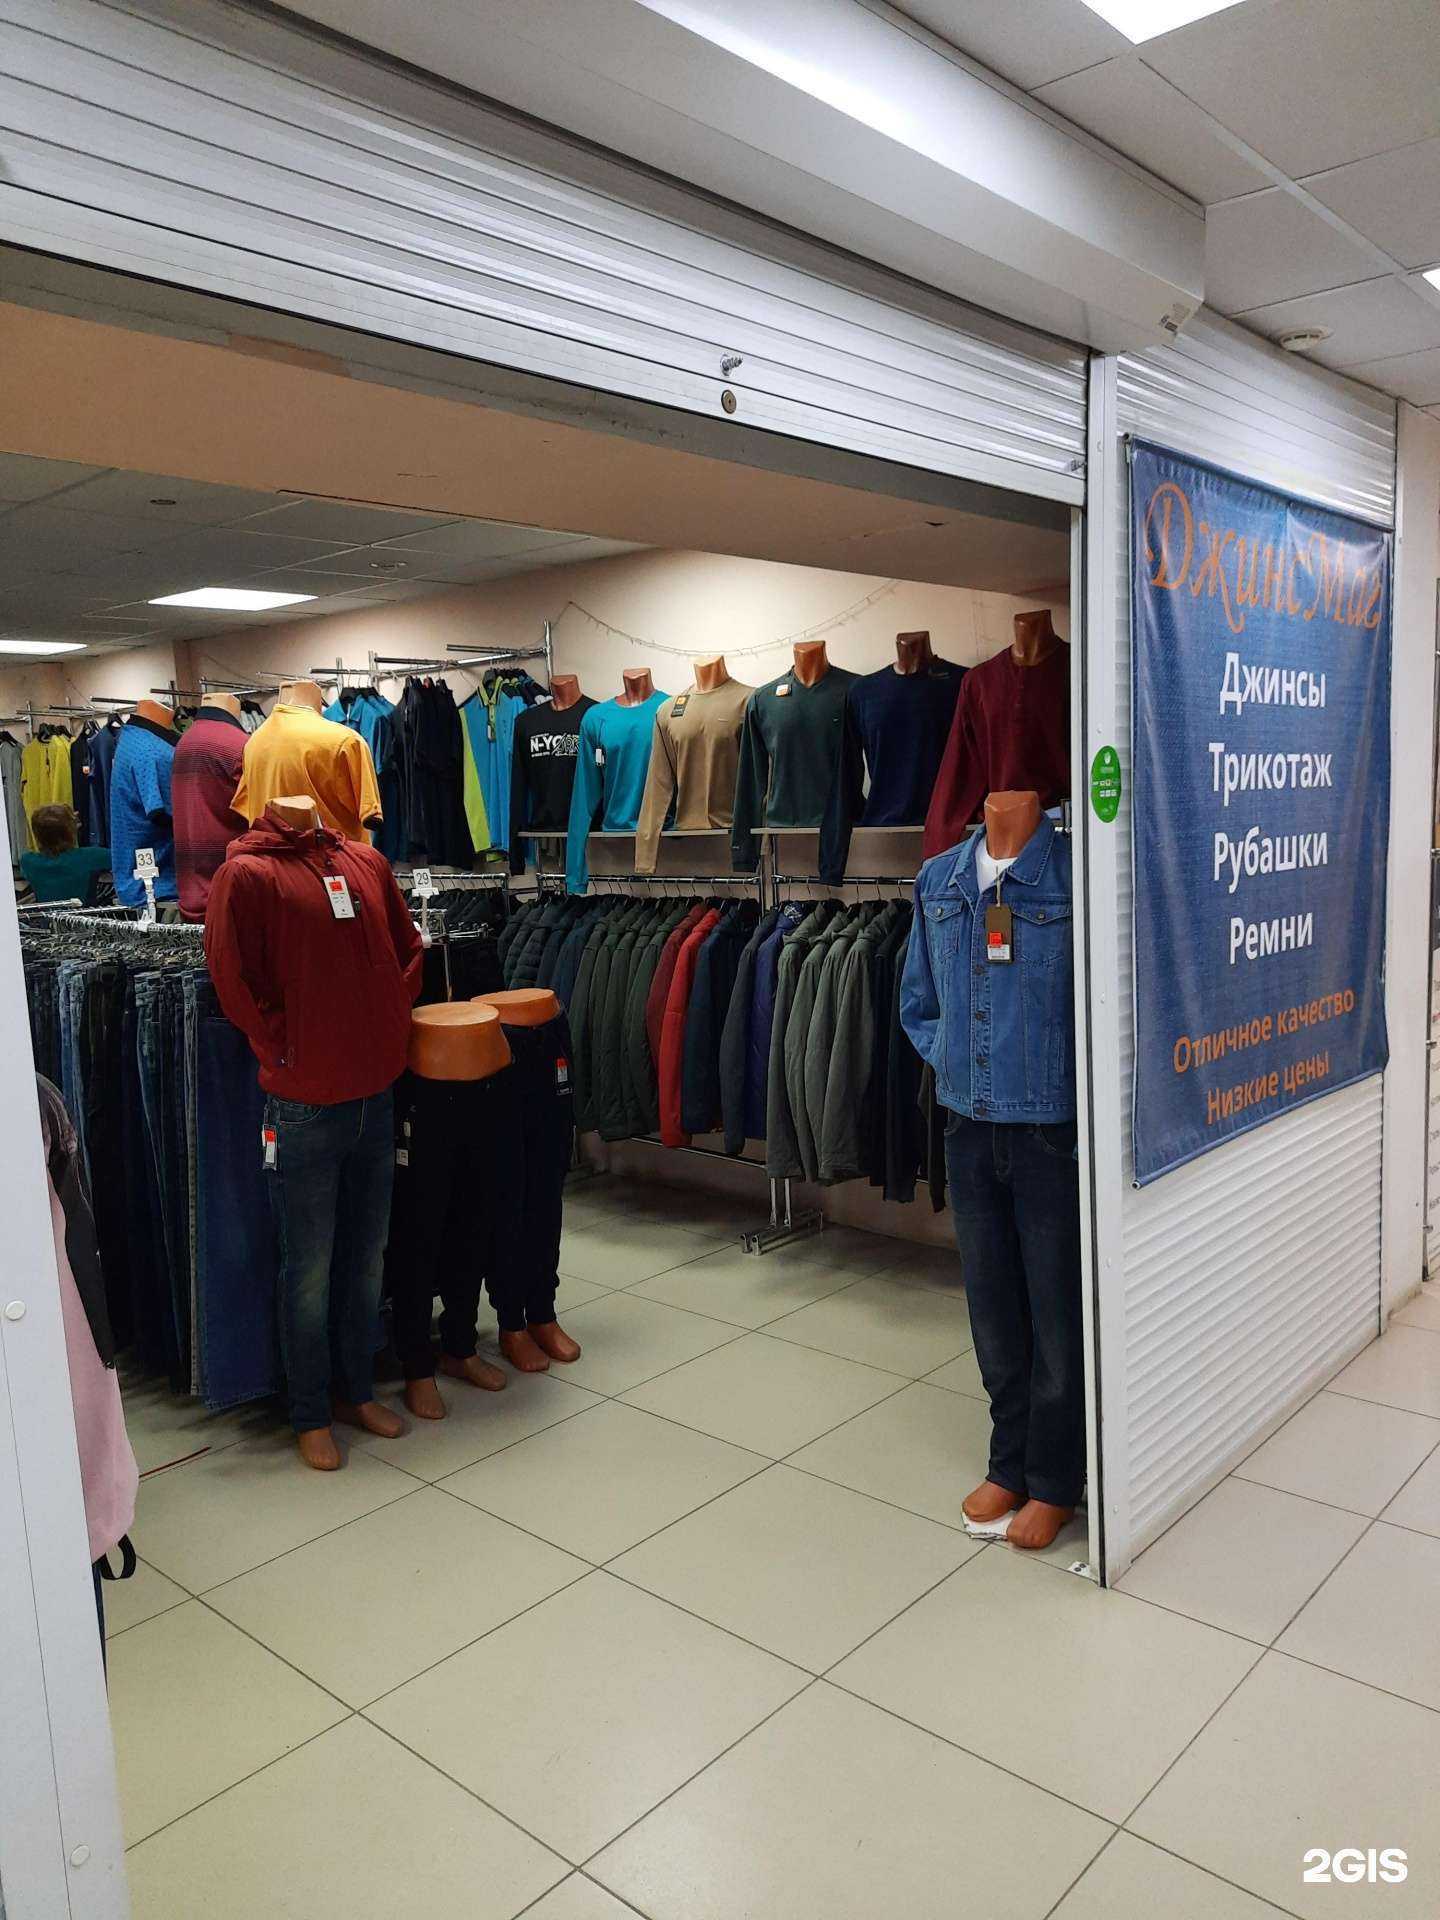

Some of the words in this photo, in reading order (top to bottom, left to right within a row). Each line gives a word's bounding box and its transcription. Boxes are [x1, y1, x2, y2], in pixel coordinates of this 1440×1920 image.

[1220, 652, 1326, 715] Джинсы
[1208, 742, 1332, 806] Трикотаж
[138, 852, 153, 866] 33
[416, 872, 429, 885] 29
[1214, 826, 1328, 893] Рубашки
[1230, 912, 1313, 965] Ремни
[1174, 1016, 1272, 1074] Отличное
[1277, 990, 1355, 1034] качество
[1207, 1074, 1279, 1125] Низкие
[1283, 1051, 1330, 1095] цены
